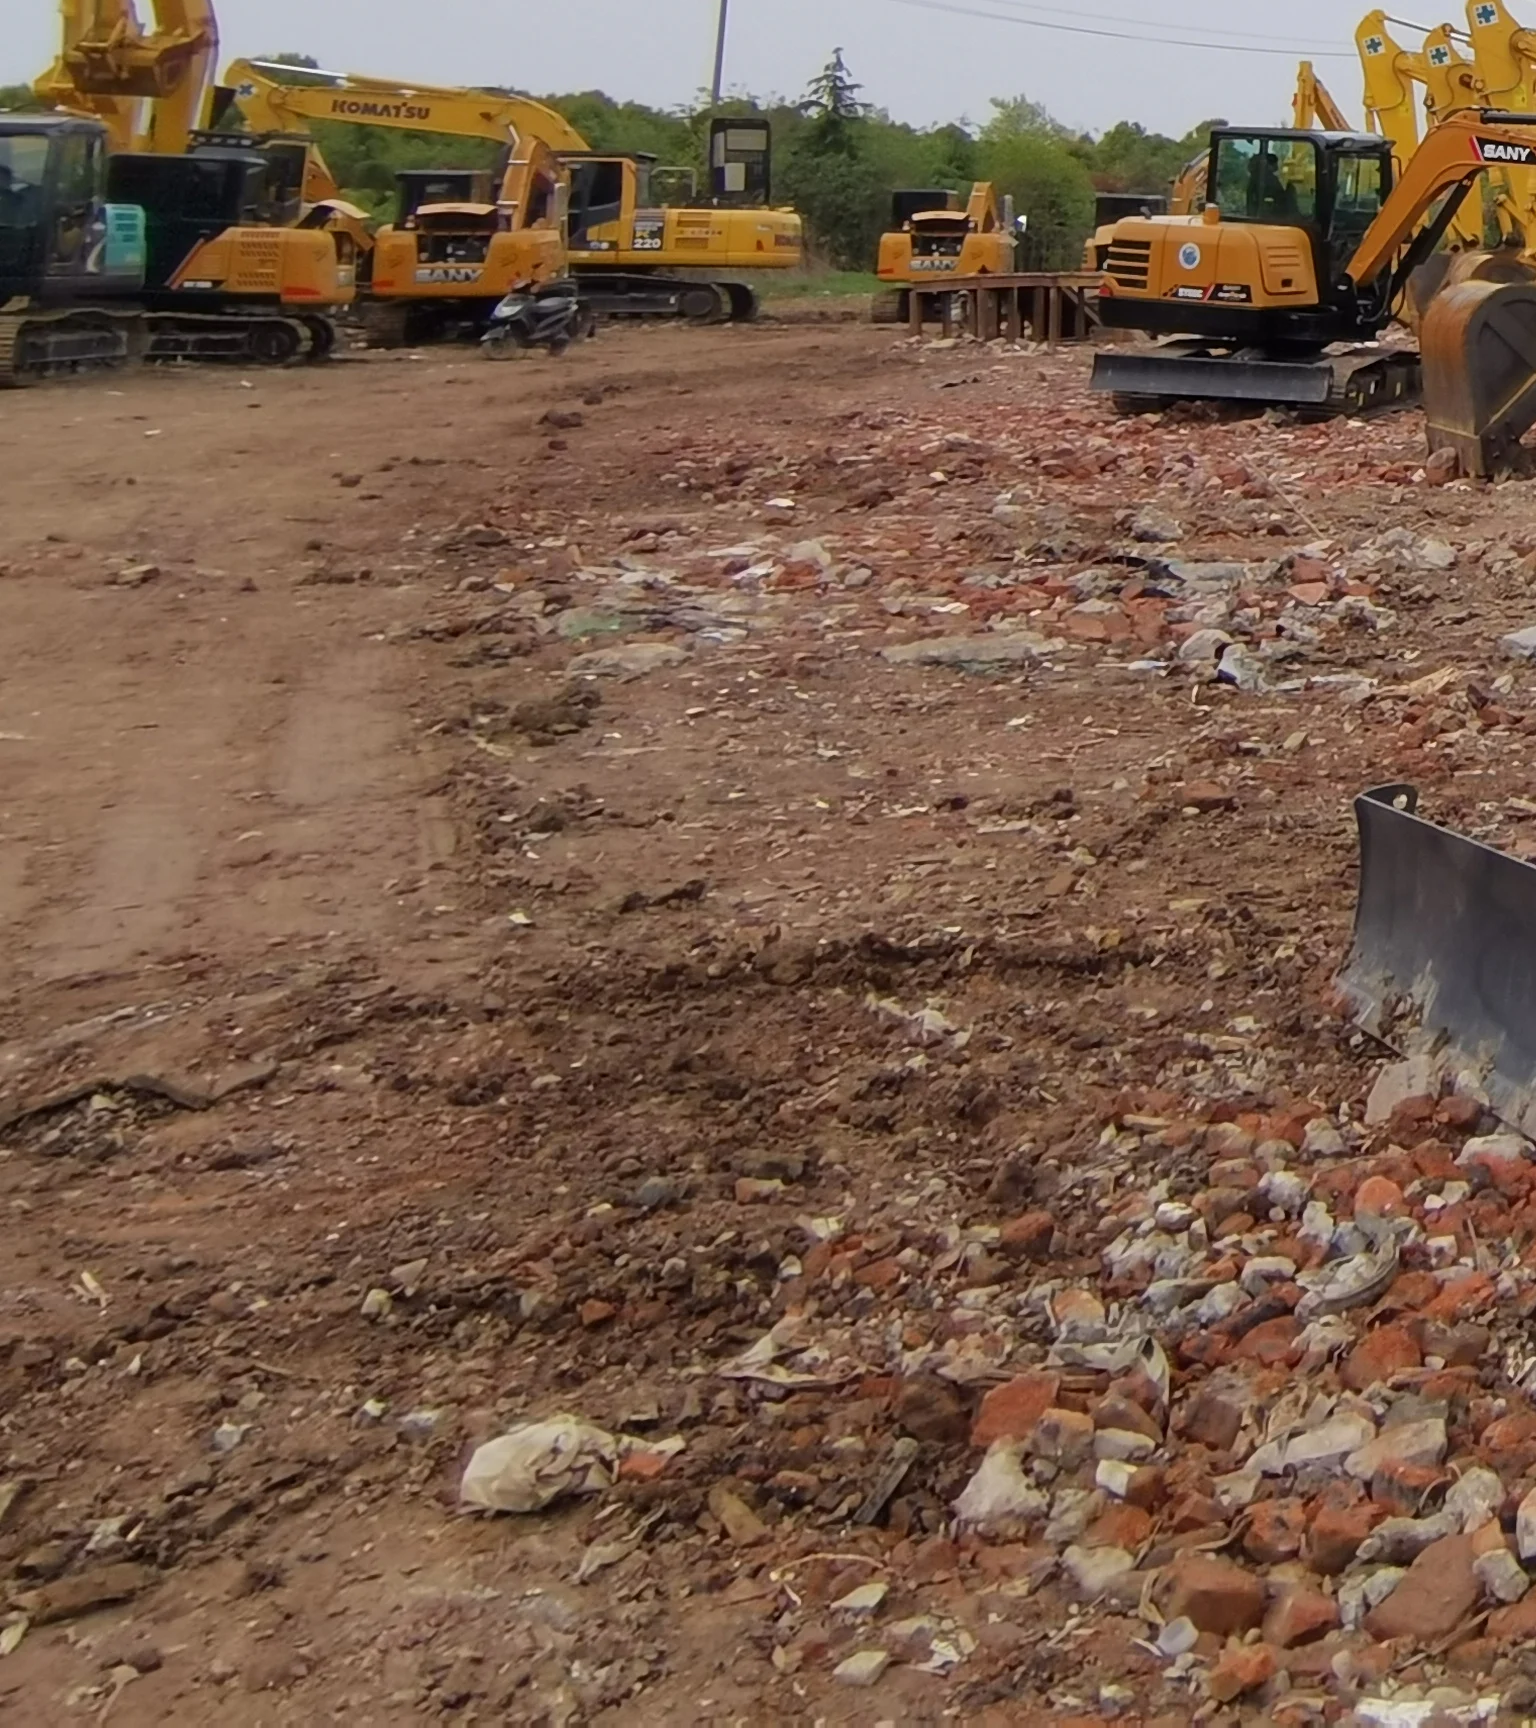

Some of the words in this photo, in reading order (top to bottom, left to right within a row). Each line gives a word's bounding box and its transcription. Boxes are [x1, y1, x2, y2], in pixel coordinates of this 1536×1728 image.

[330, 99, 431, 120] KOMATSU
[1483, 143, 1531, 162] SANY
[633, 237, 662, 249] 220
[415, 268, 485, 283] SANY
